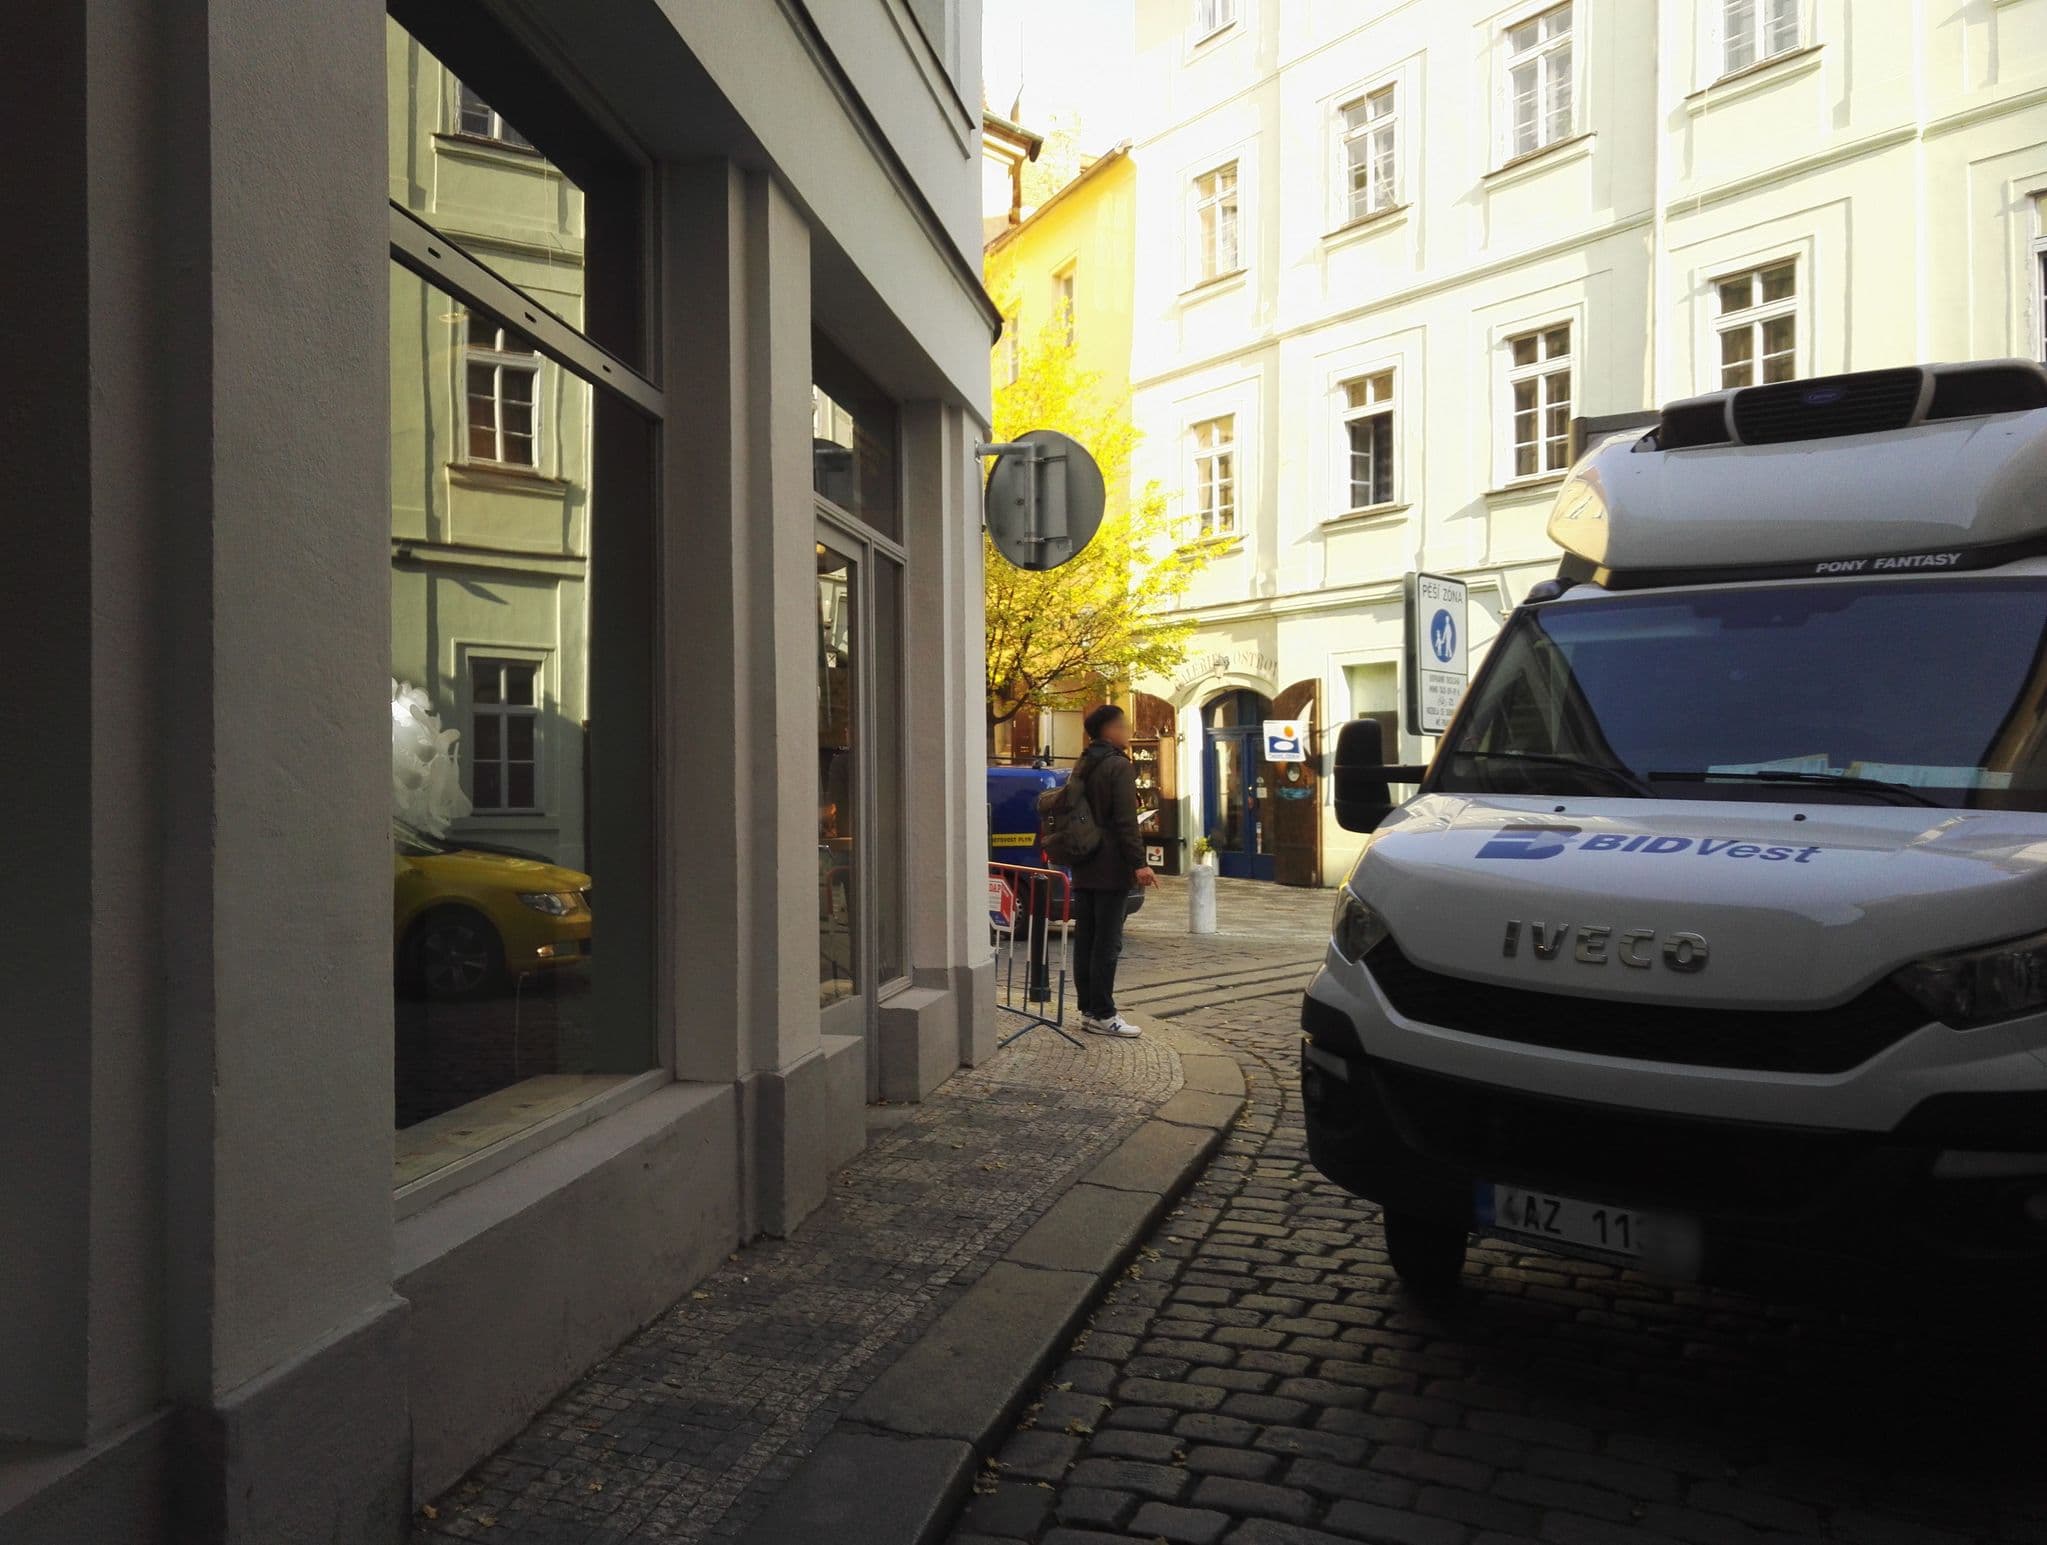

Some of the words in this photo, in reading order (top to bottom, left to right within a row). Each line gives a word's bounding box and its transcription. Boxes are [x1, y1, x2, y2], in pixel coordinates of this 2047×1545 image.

[1815, 559, 1868, 573] PONY
[1873, 553, 1962, 569] FANTASY
[1442, 586, 1463, 604] ZÓNA
[1578, 834, 1822, 863] BIDVest
[1502, 920, 1710, 973] IVECO
